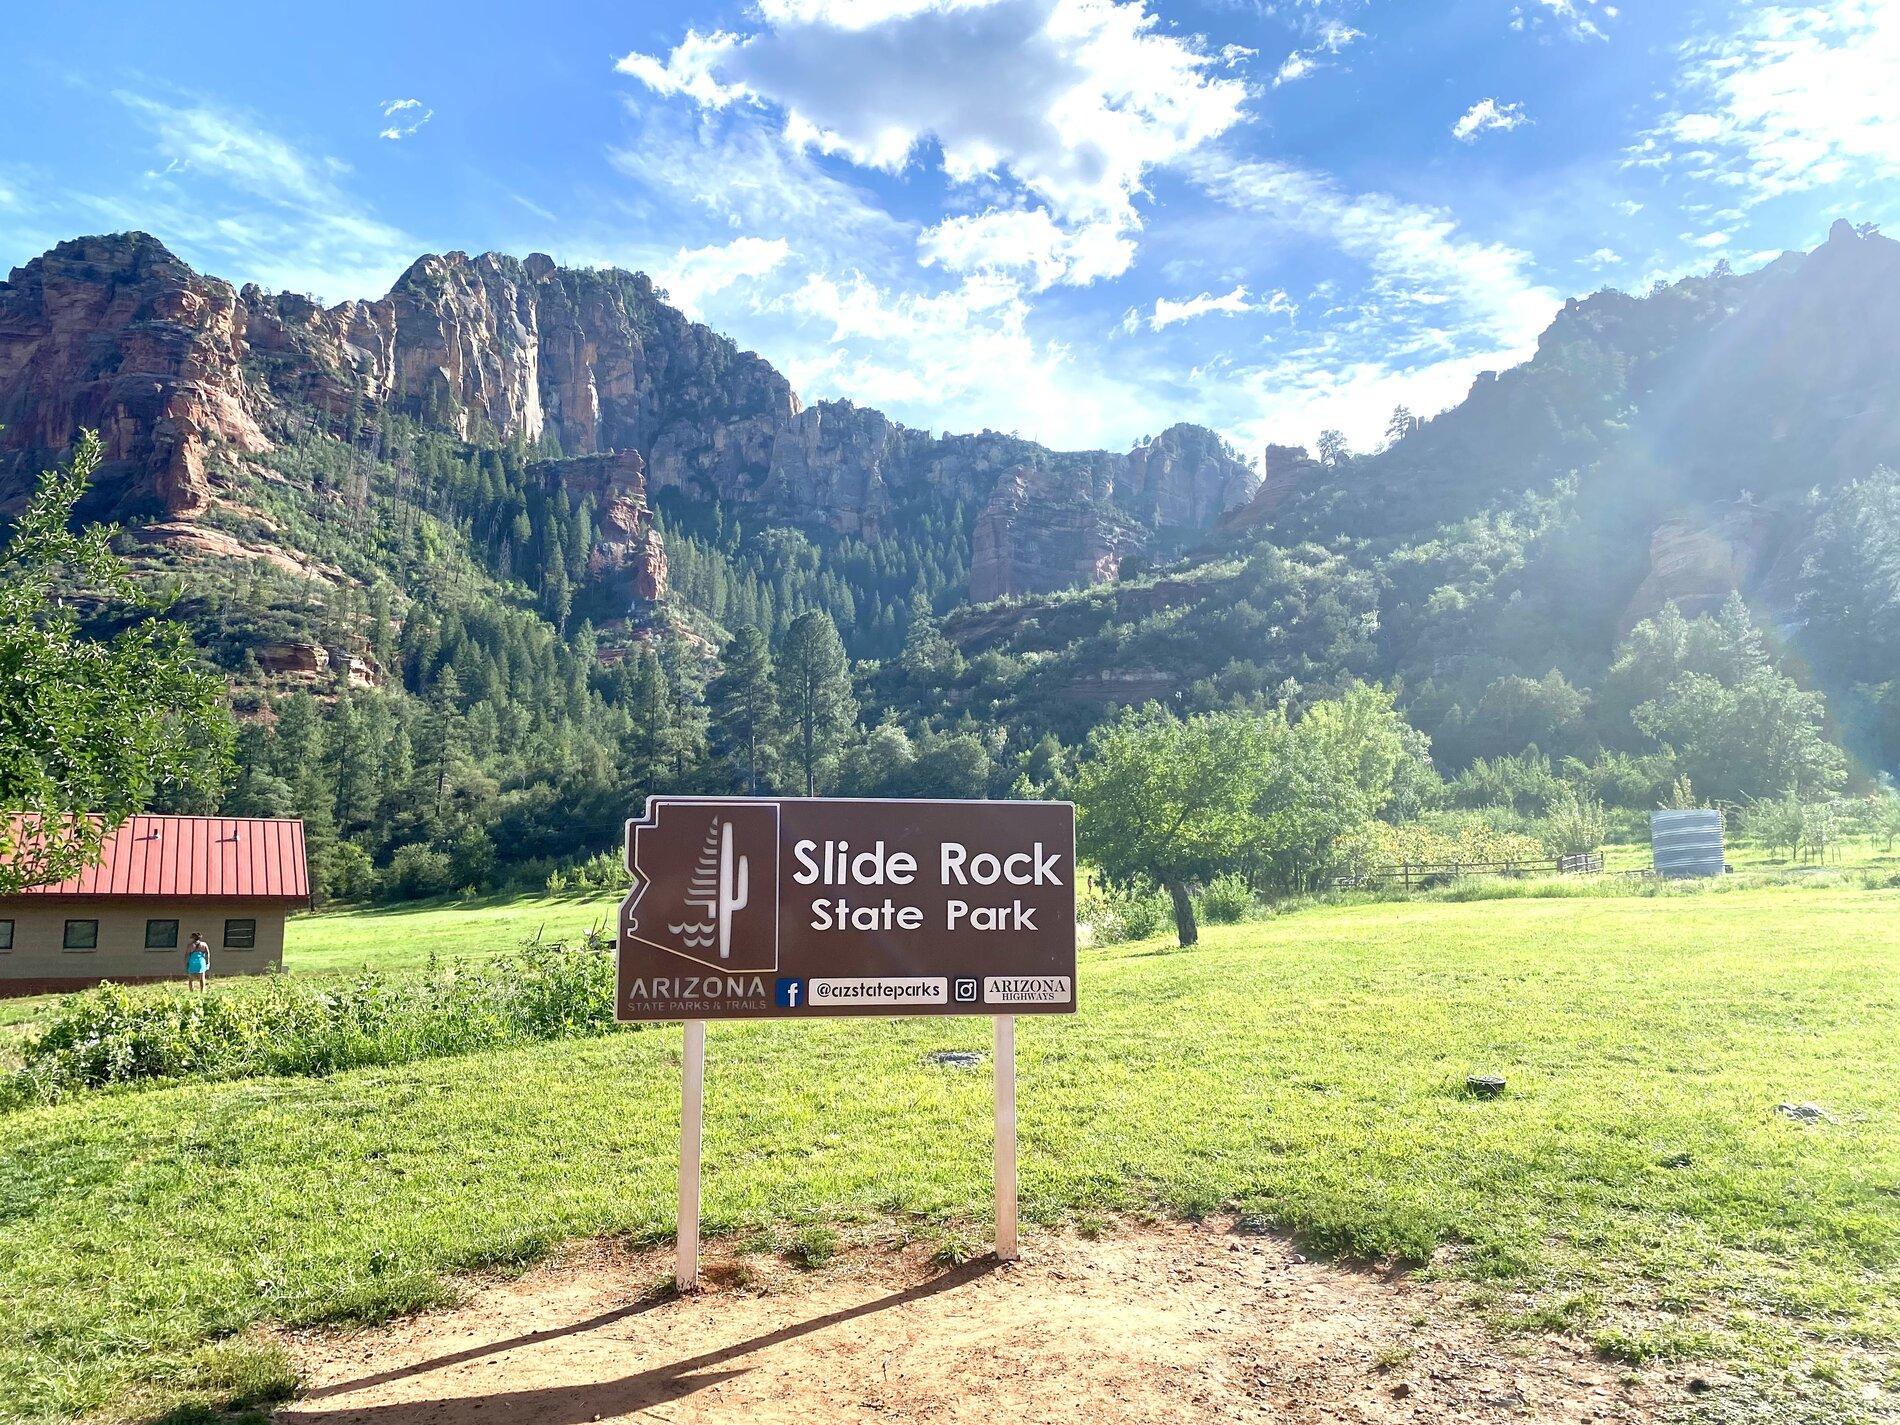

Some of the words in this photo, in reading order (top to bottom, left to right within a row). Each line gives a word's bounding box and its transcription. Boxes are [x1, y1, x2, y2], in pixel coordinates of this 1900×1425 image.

[793, 839, 918, 886] Slide
[941, 842, 1064, 886] Rock
[810, 899, 924, 931] State
[947, 900, 1039, 931] Park
[629, 976, 766, 999] ARIZONA
[816, 981, 940, 1000] @azstateparks
[989, 979, 1066, 993] ARIZONA
[627, 1001, 667, 1012] STATE
[670, 1001, 709, 1011] PARKS
[713, 1001, 721, 1010] &
[725, 1000, 767, 1011] TRAILS
[1002, 992, 1055, 1001] HIGHWAYS
